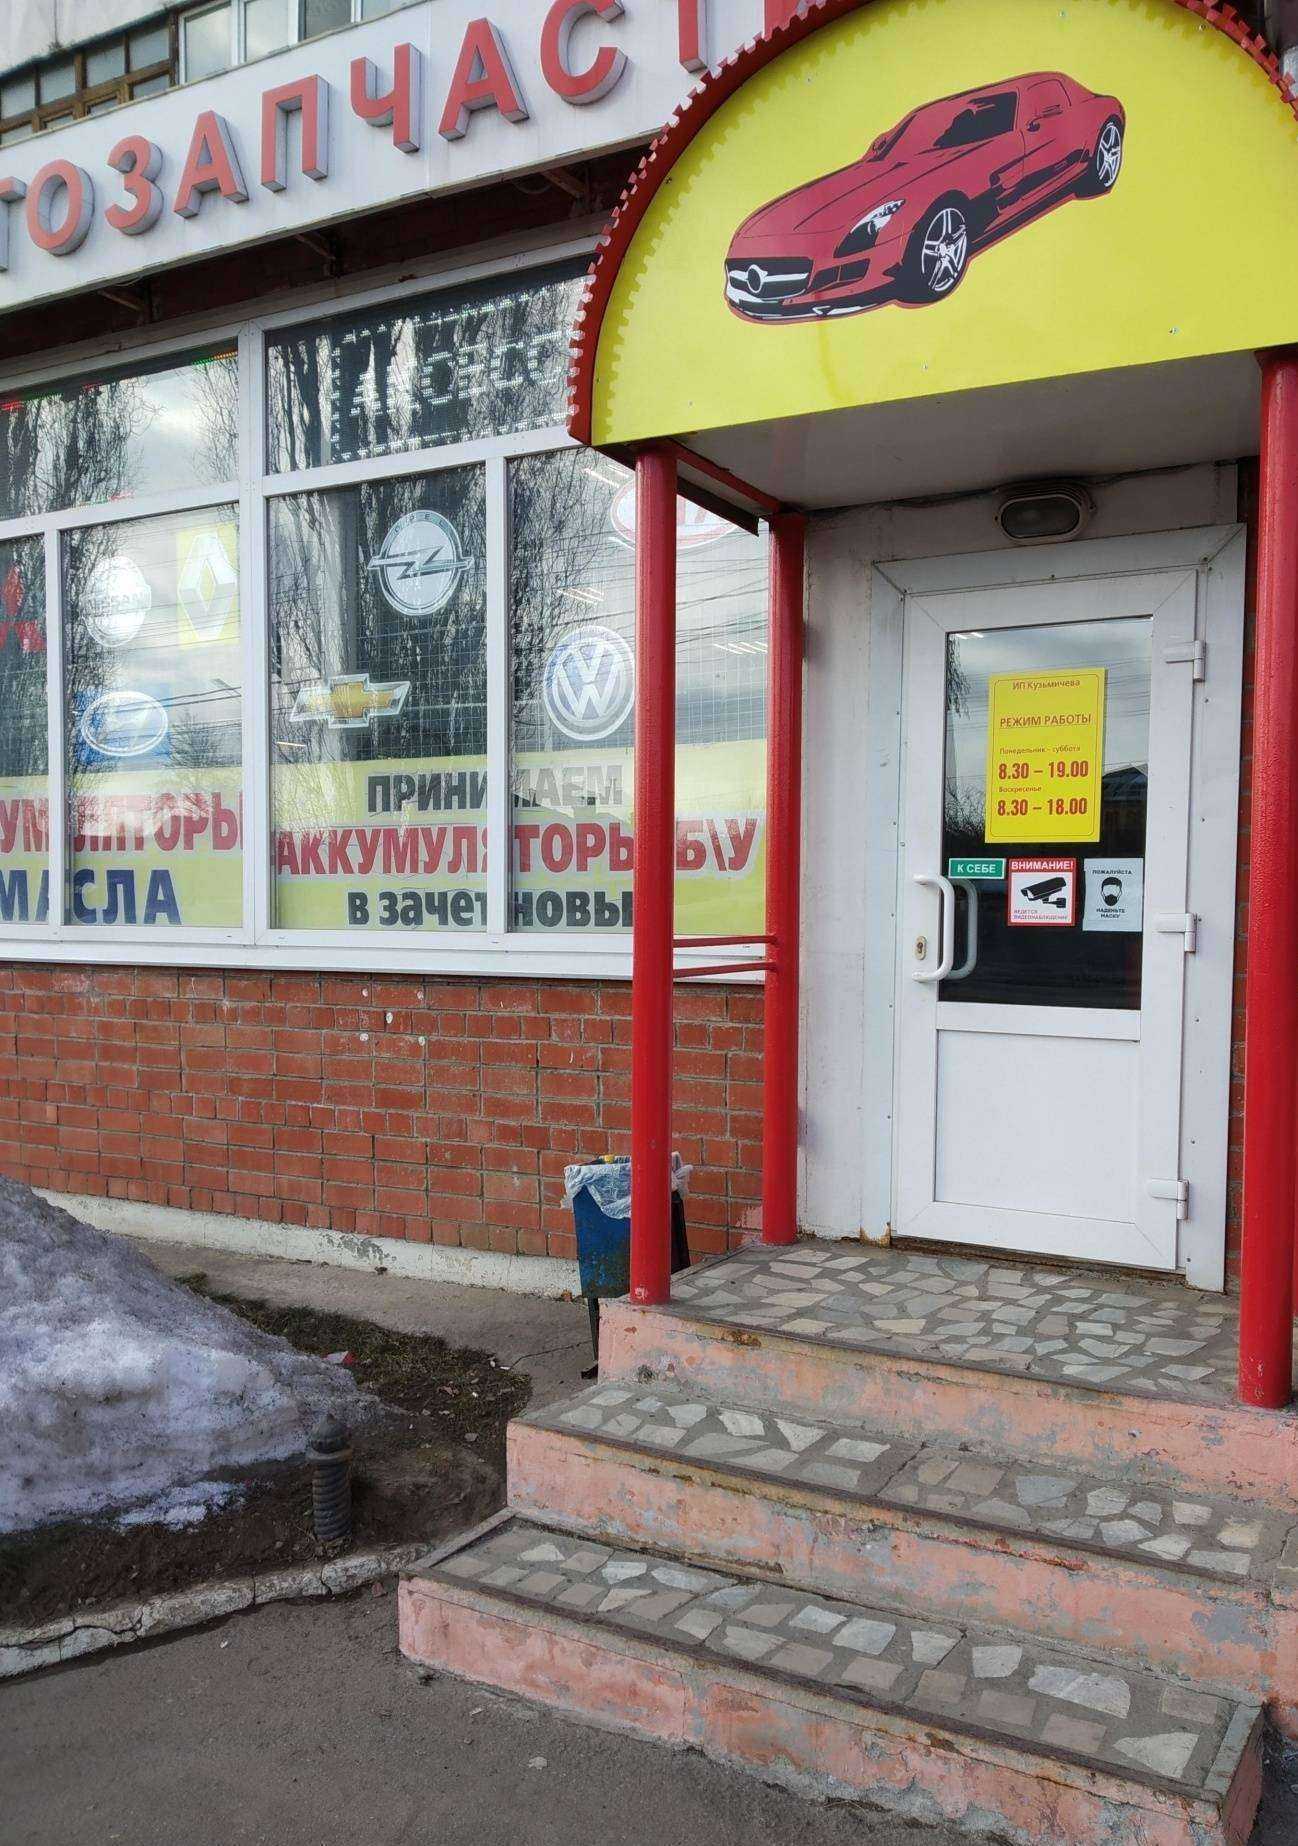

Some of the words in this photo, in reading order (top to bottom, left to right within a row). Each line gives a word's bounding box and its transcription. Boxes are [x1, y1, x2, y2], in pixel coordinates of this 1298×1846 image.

[0, 0, 808, 272] ОЗАПЧАС
[1012, 681, 1026, 691] ИП
[1027, 680, 1080, 692] Кузьмичева
[1000, 716, 1042, 727] РЕЖИМ
[1044, 714, 1092, 725] РАБОТЫ
[999, 746, 1045, 756] Понедельник
[1053, 745, 1081, 754] суббота
[998, 763, 1030, 779] 8.30
[1049, 760, 1089, 778] 19.00
[999, 786, 1042, 795] Воскресенье
[997, 799, 1029, 816] 8.30
[1047, 797, 1088, 816] 18.00
[0, 791, 243, 854] УМЛЯТОРЫ
[277, 822, 634, 875] АККУМУЛТОРЫ
[957, 864, 964, 873] К
[964, 863, 996, 873] СЕБЕ
[1011, 860, 1074, 871] ВНИМАНИЕ!
[513, 890, 634, 928] новы
